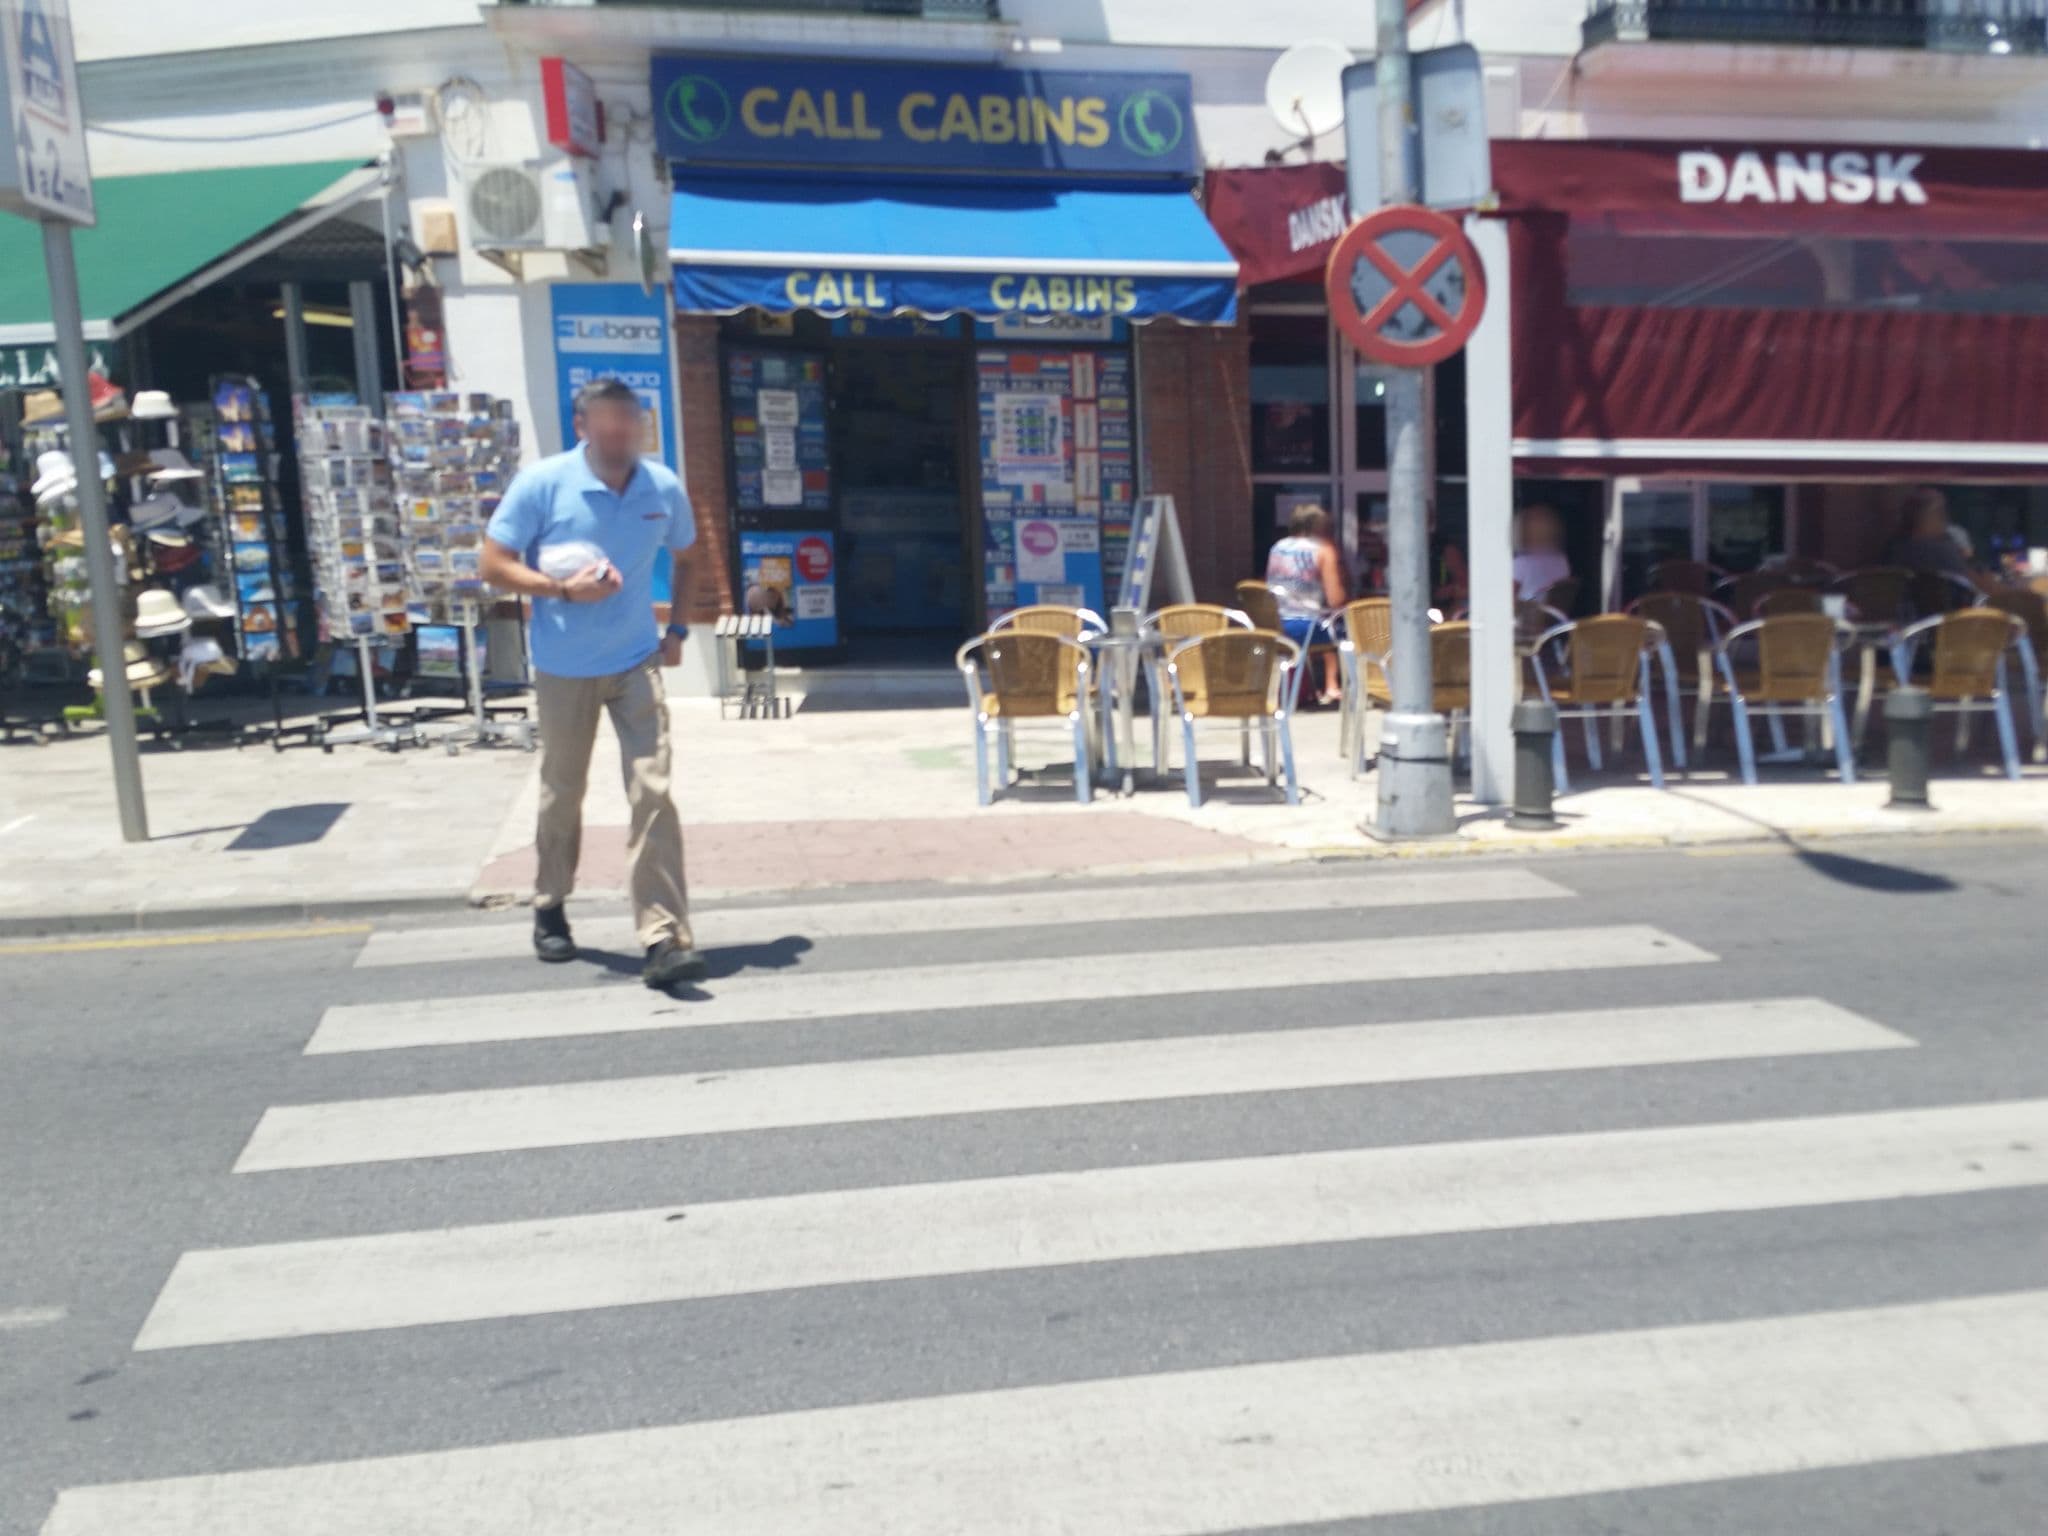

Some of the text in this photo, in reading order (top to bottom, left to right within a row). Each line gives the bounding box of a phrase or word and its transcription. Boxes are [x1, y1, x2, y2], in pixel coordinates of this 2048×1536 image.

[741, 87, 1111, 148] CALL CABINS
[1678, 150, 1929, 205] DANSK
[1288, 193, 1348, 252] DANSK
[786, 272, 1137, 313] CALL CABINS
[577, 321, 661, 340] Lebara
